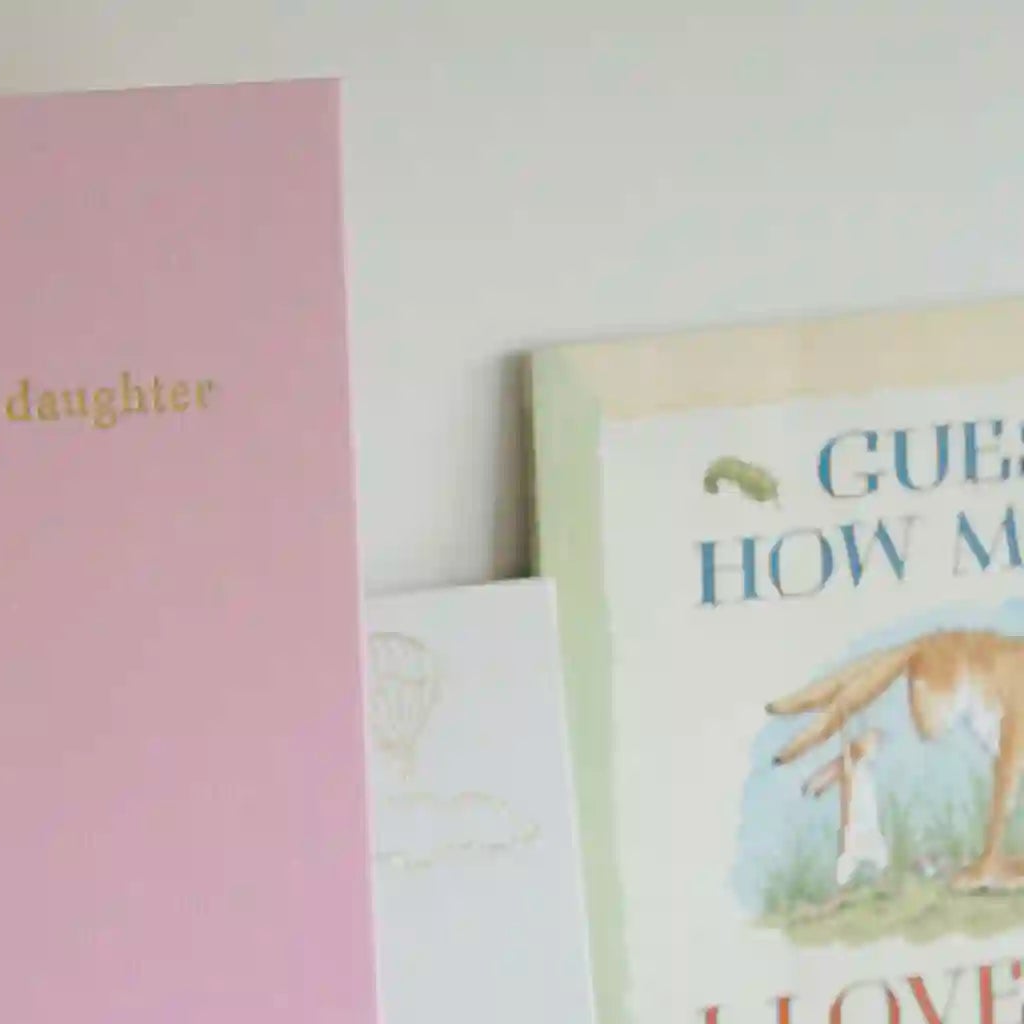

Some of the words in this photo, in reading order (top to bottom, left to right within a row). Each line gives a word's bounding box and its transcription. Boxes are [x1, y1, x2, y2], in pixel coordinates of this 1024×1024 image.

[5, 371, 216, 430] daughter
[817, 416, 1024, 499] GUE
[694, 514, 921, 607] HOW
